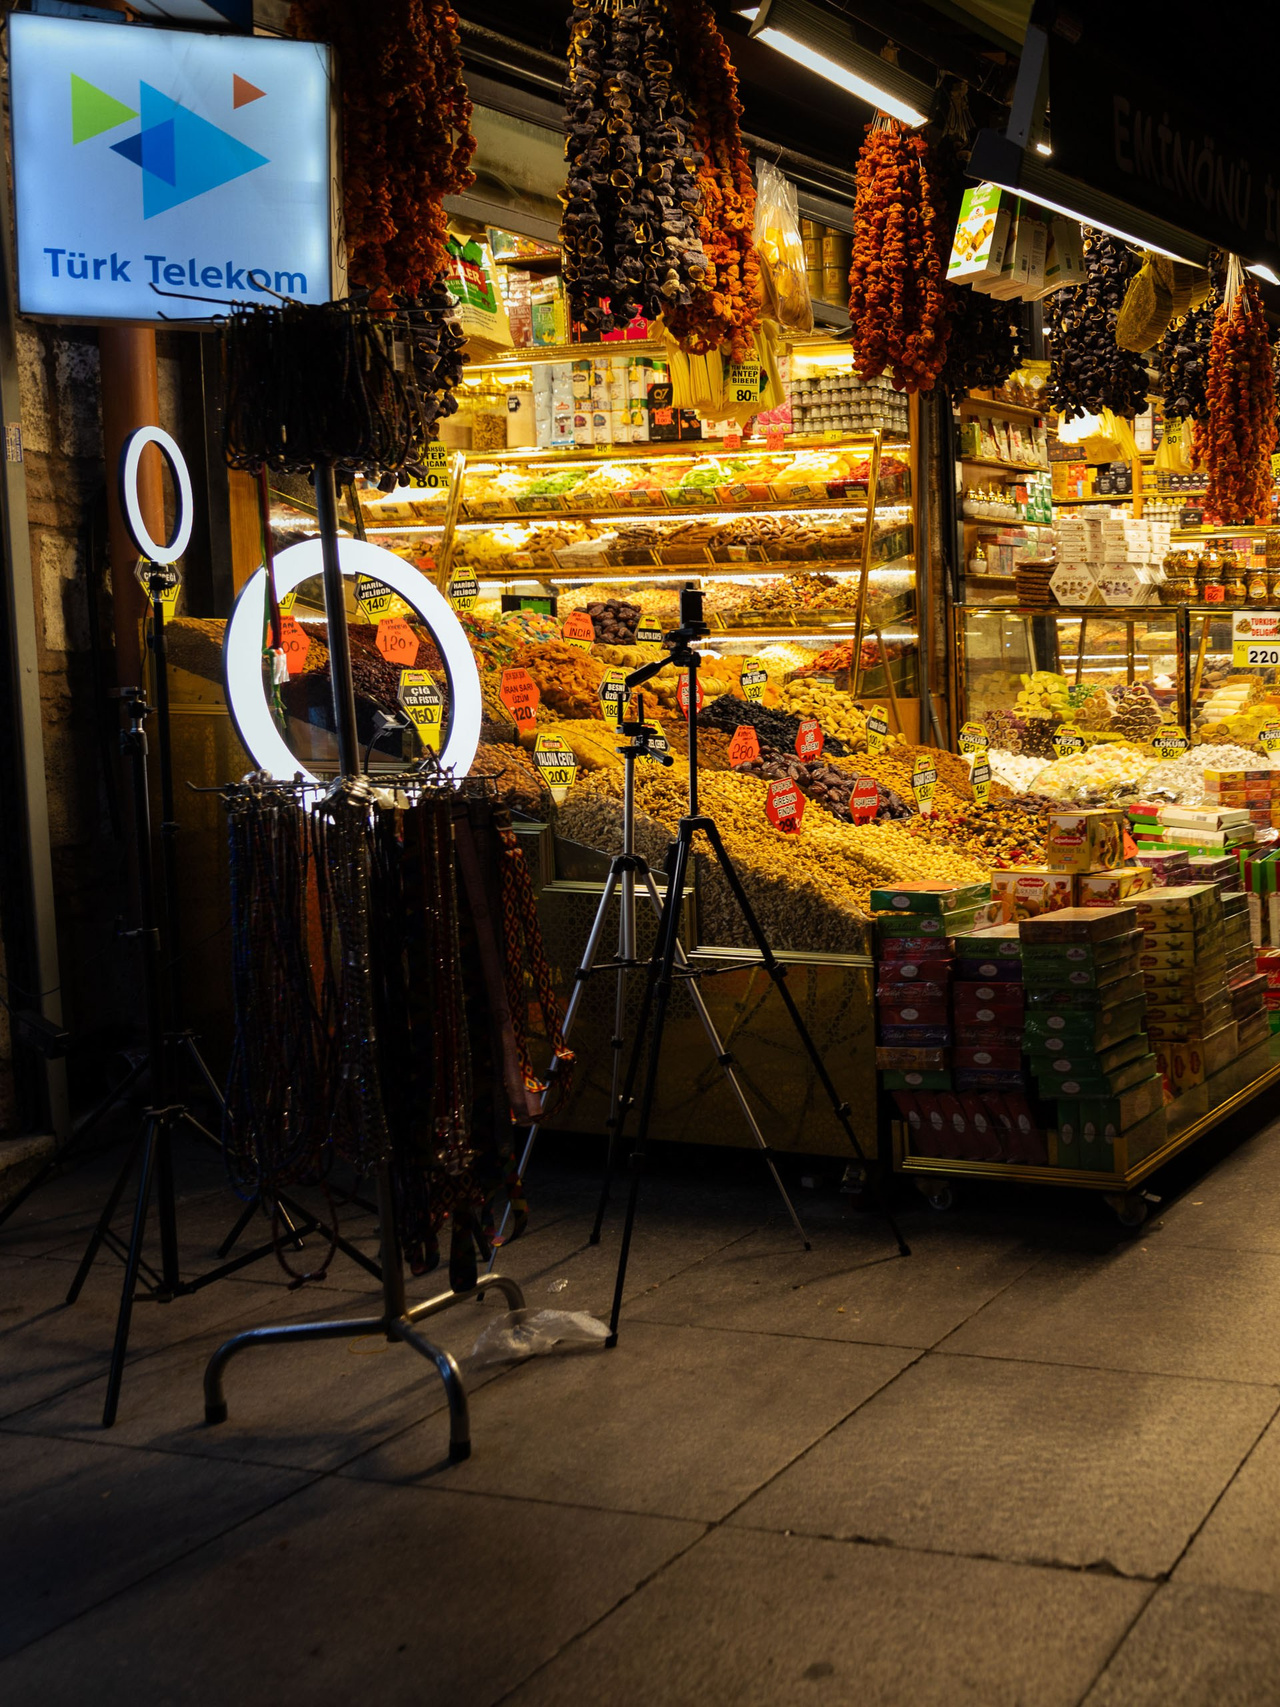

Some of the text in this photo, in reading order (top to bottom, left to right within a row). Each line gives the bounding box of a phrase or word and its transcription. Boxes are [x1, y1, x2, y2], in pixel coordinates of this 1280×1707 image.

[1112, 93, 1253, 233] EMİNÖNÜ
[44, 247, 307, 294] Türk Telekom
[653, 388, 669, 399] Q7
[736, 389, 751, 402] 80
[1167, 436, 1177, 444] 80
[361, 582, 384, 590] HARİB
[360, 588, 391, 599] JELİBON
[452, 588, 477, 597] JELİBON
[1251, 617, 1278, 626] TURKISH
[1251, 627, 1278, 637] DELIGHT
[1249, 650, 1279, 665] 220
[504, 683, 533, 695] İRAN SARI
[404, 694, 440, 705] YER FISTIK
[512, 693, 529, 704] ÜZÜM
[959, 734, 987, 745] LOKUM
[1055, 737, 1082, 747] VEZİR
[1154, 739, 1187, 748] LOKUM
[800, 742, 820, 754] BADEM
[536, 752, 558, 766] YALOVA
[772, 792, 798, 808] GİRESUN
[777, 804, 797, 818] FINDIK
